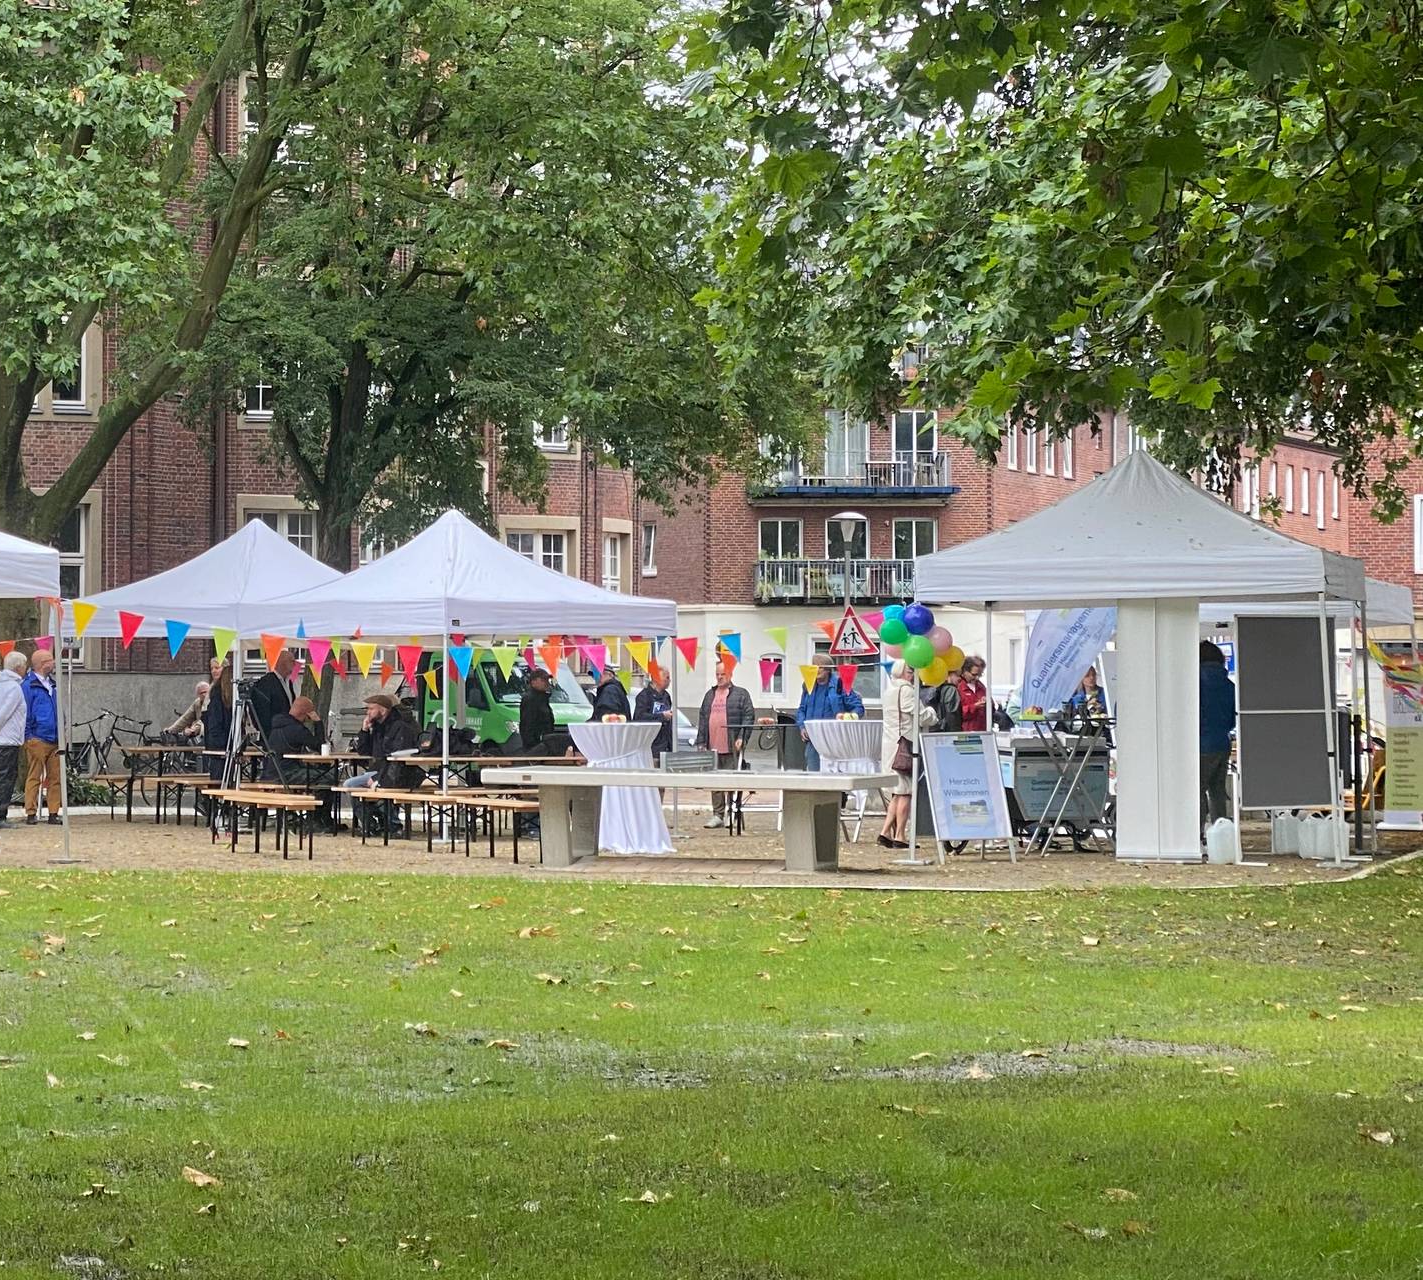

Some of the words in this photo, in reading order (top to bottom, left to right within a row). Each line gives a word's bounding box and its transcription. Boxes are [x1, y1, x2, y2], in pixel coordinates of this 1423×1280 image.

[1031, 608, 1095, 689] Quartiersmanagem
[948, 777, 981, 785] Herzlich
[943, 788, 990, 797] Willkommen
